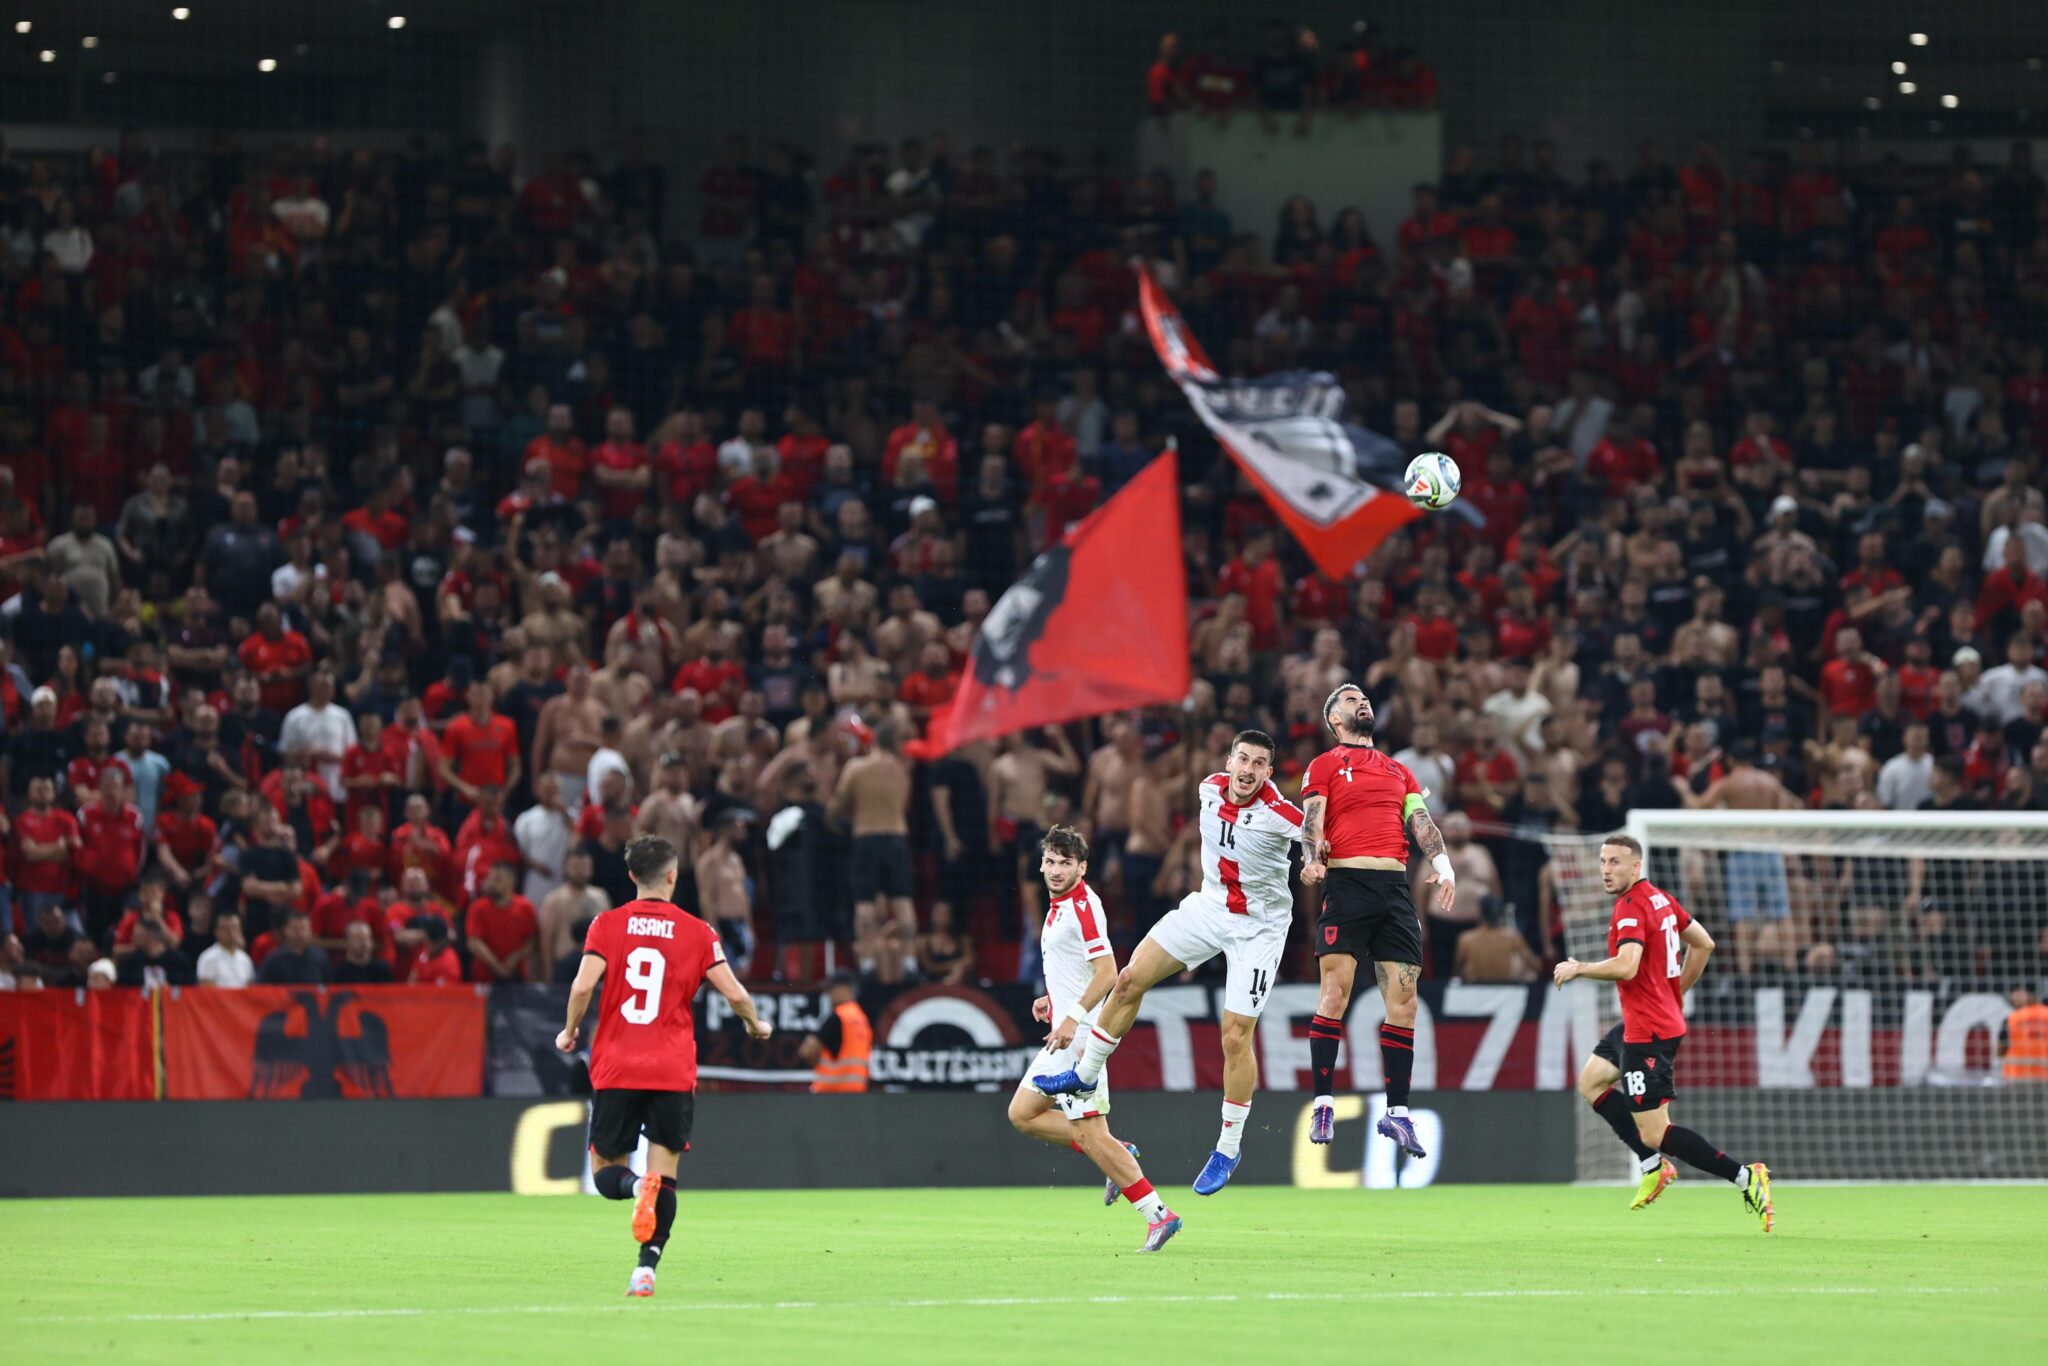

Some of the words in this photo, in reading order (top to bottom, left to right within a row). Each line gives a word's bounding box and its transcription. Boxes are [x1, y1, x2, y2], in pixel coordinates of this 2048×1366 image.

[1219, 820, 1236, 850] 14
[627, 916, 676, 939] ASANI
[620, 946, 666, 1025] 9
[1249, 968, 1267, 997] 14
[1624, 1070, 1646, 1096] 18
